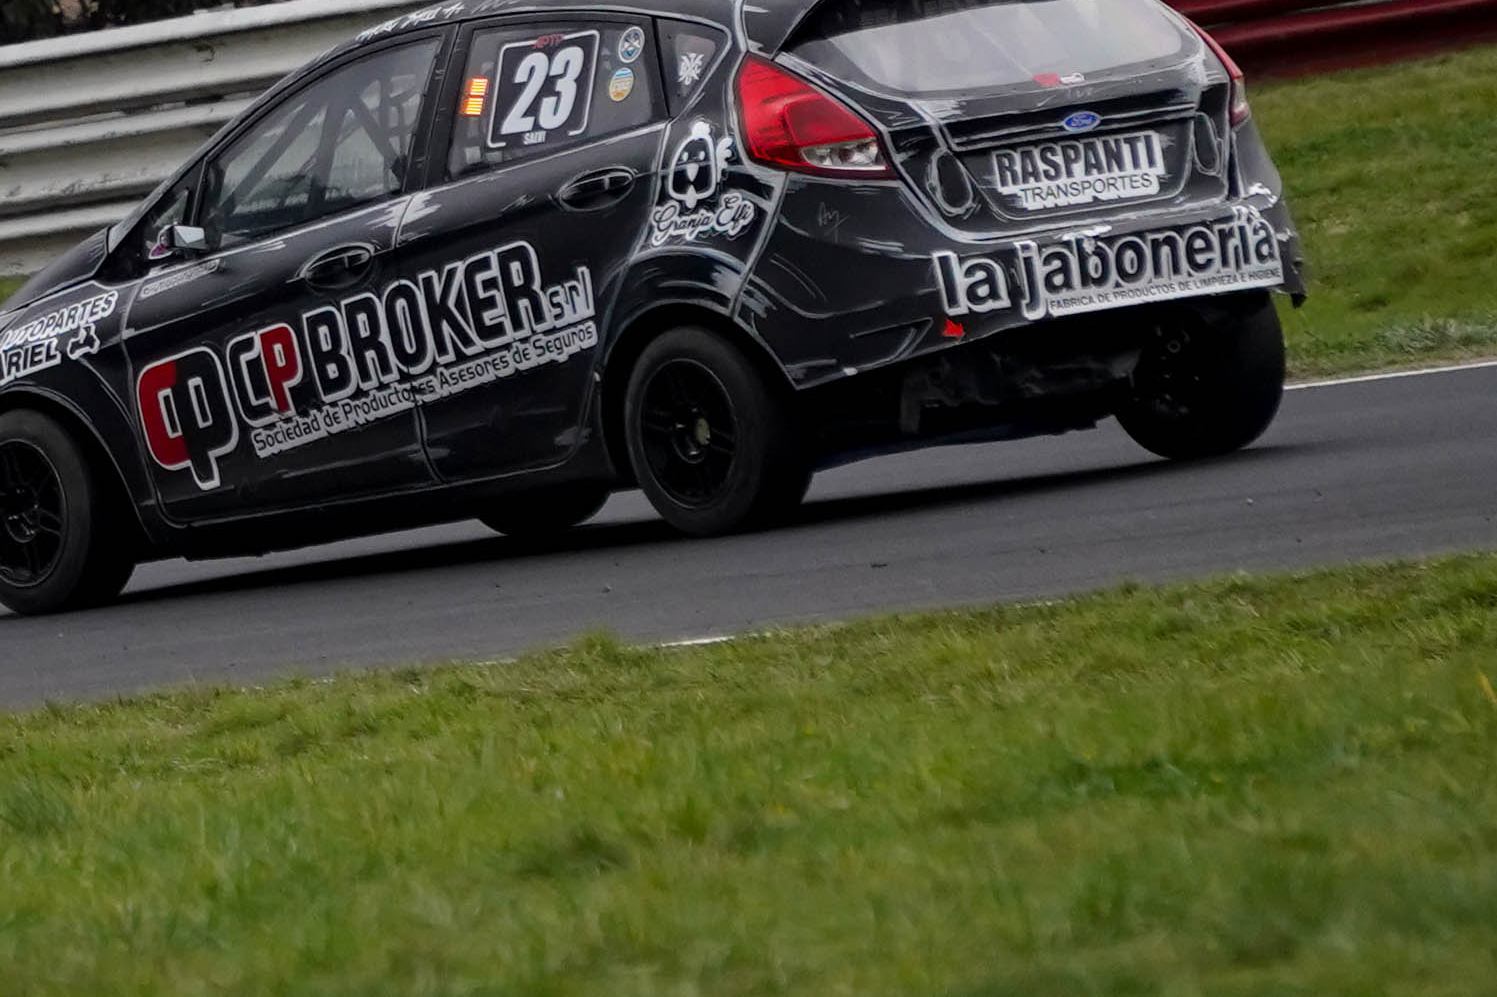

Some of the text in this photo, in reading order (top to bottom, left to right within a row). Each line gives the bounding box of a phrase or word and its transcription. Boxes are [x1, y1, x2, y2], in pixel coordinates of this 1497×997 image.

[500, 46, 585, 135] 23
[995, 133, 1157, 188] RASPANTI
[1021, 172, 1153, 204] TRANSPORTES
[935, 252, 1003, 313] la
[1097, 292, 1112, 303] DE
[1113, 282, 1176, 300] PRODUCTOS
[1178, 281, 1192, 291] DE
[1195, 274, 1238, 290] LIMPIEZA
[302, 241, 548, 402] BROKER
[253, 323, 594, 452] Sociedad de Productores Asesores de Seguros
